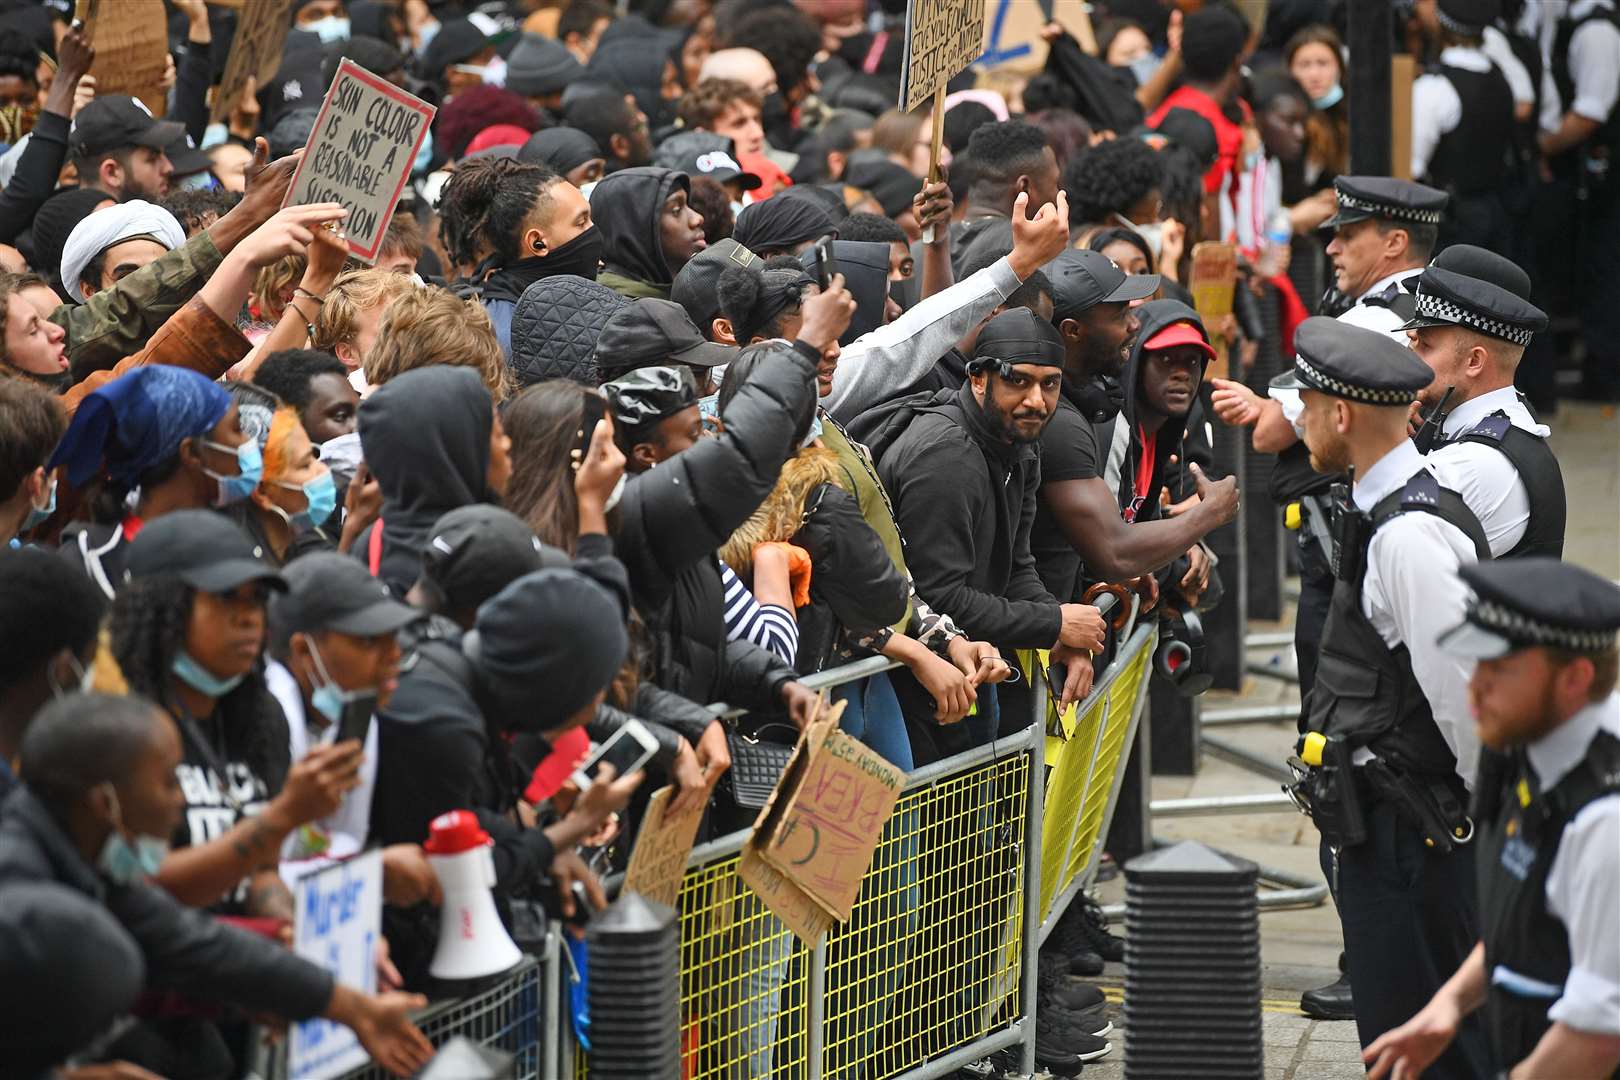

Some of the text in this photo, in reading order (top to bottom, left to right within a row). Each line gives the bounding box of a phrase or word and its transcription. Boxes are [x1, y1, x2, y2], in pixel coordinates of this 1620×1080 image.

[910, 40, 948, 89] JUSTICE
[912, 25, 930, 57] GIVE
[931, 18, 946, 46] YOU
[332, 76, 421, 148] SKIN COLOUR
[311, 141, 384, 197] REASONABLE
[324, 114, 398, 174] IS NOT A
